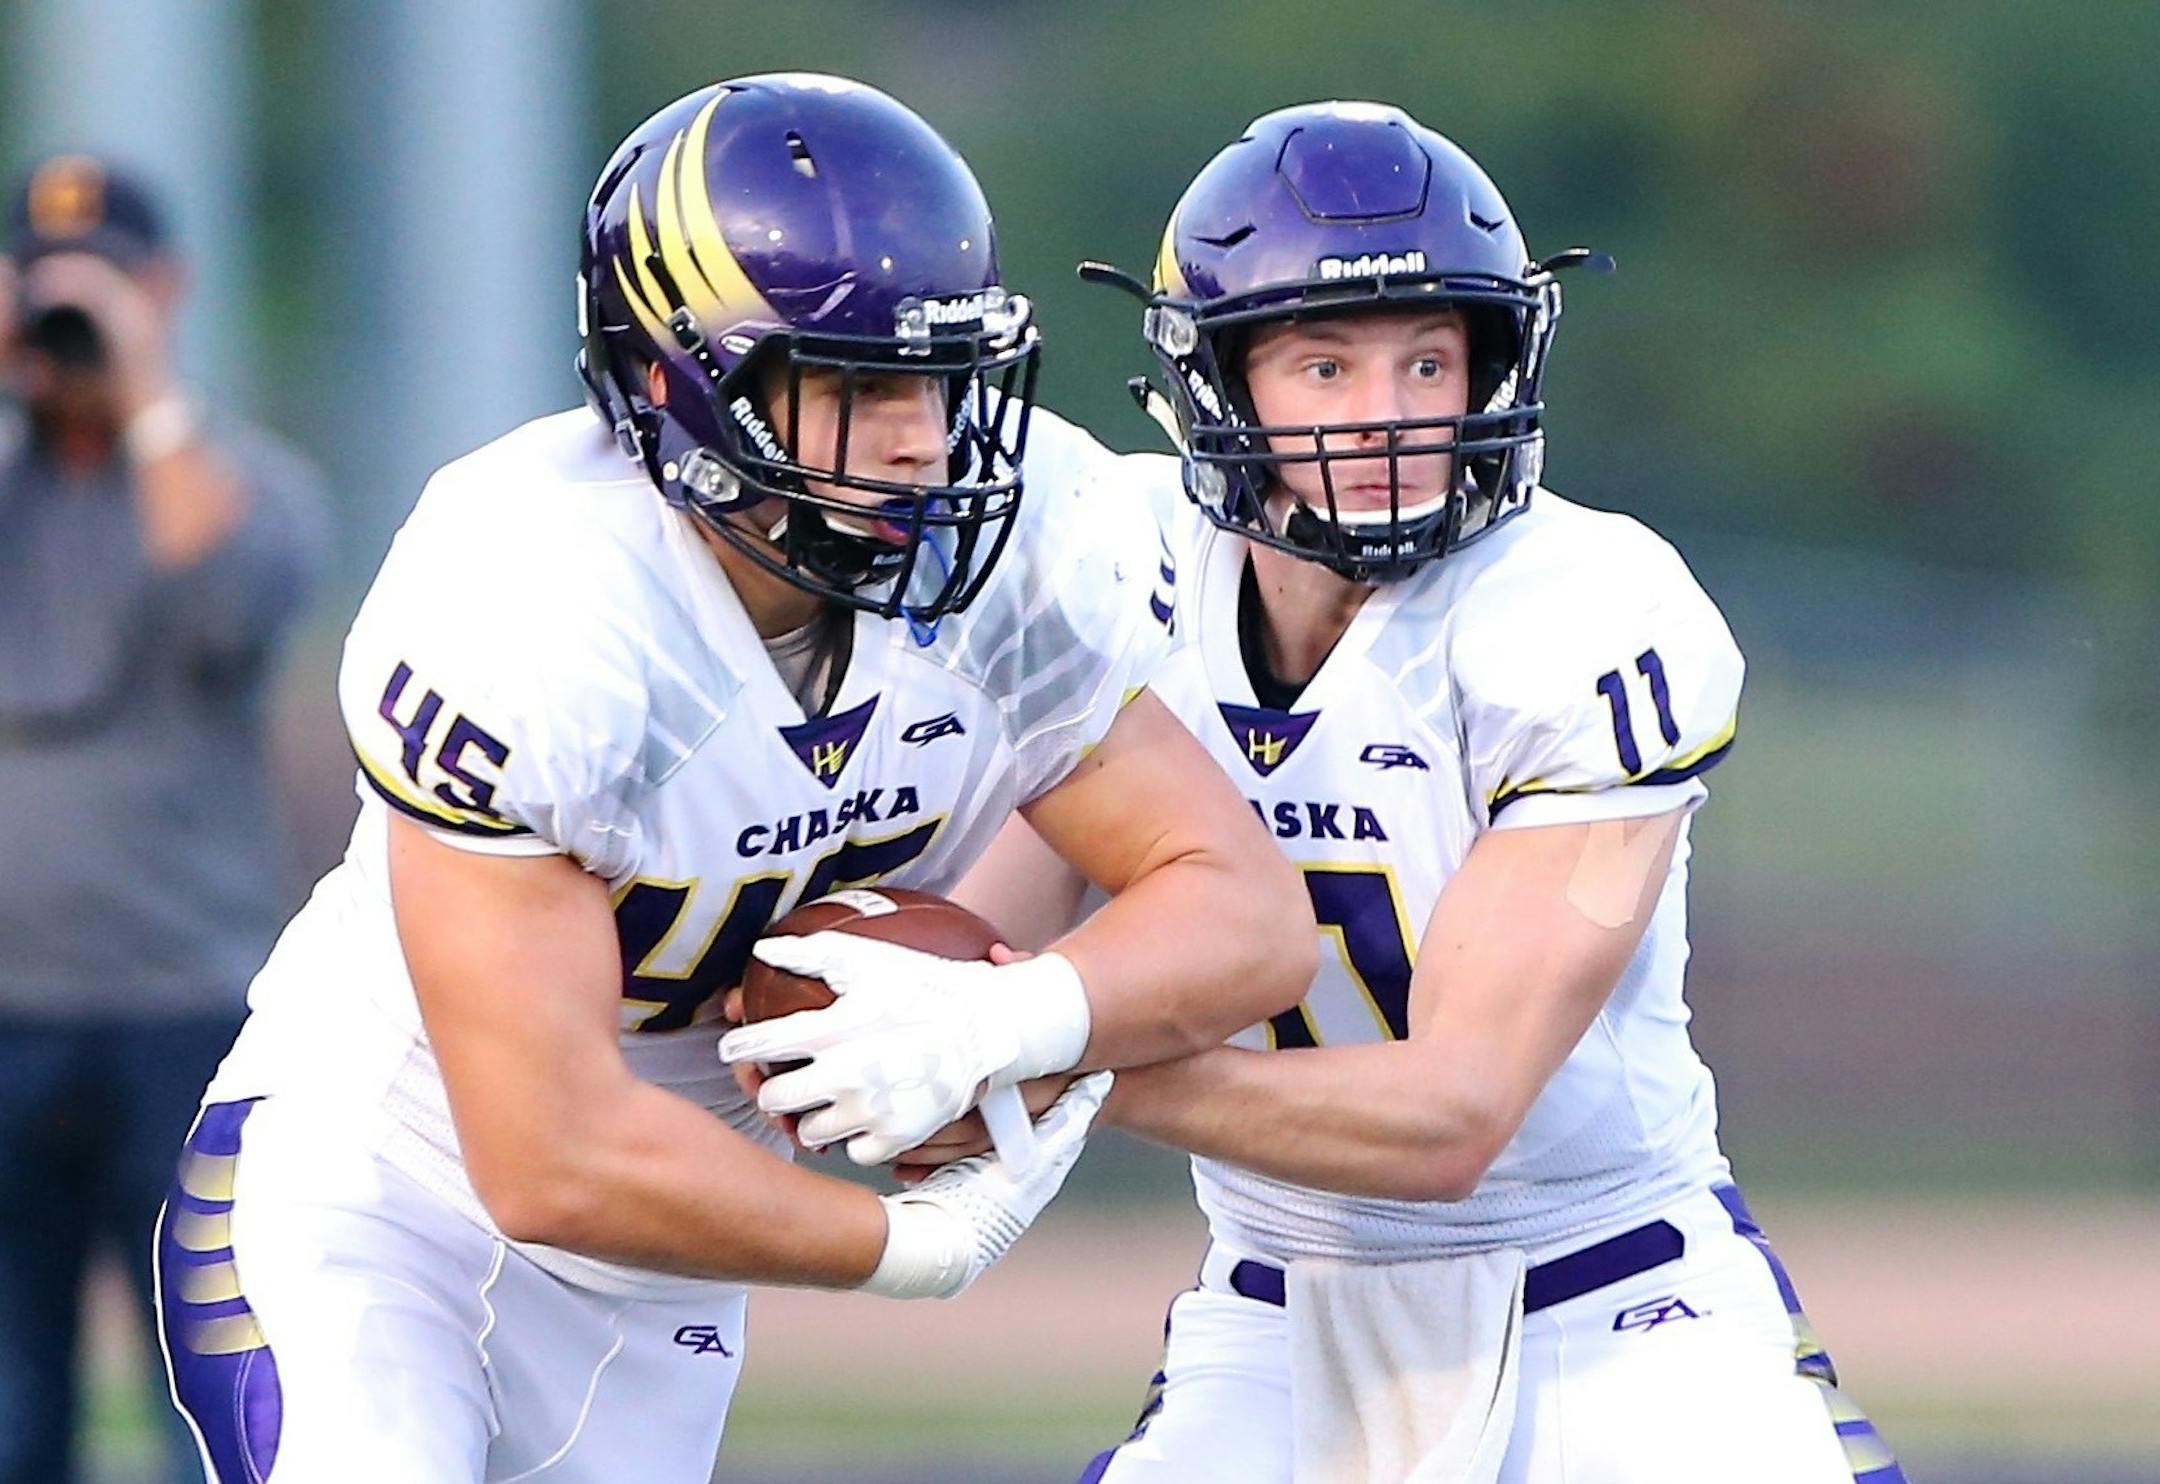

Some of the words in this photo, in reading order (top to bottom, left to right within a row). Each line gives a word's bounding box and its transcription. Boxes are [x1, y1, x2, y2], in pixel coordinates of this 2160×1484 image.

[378, 660, 511, 819] 45
[1597, 647, 1681, 776] 11
[737, 787, 920, 857] CHASKA
